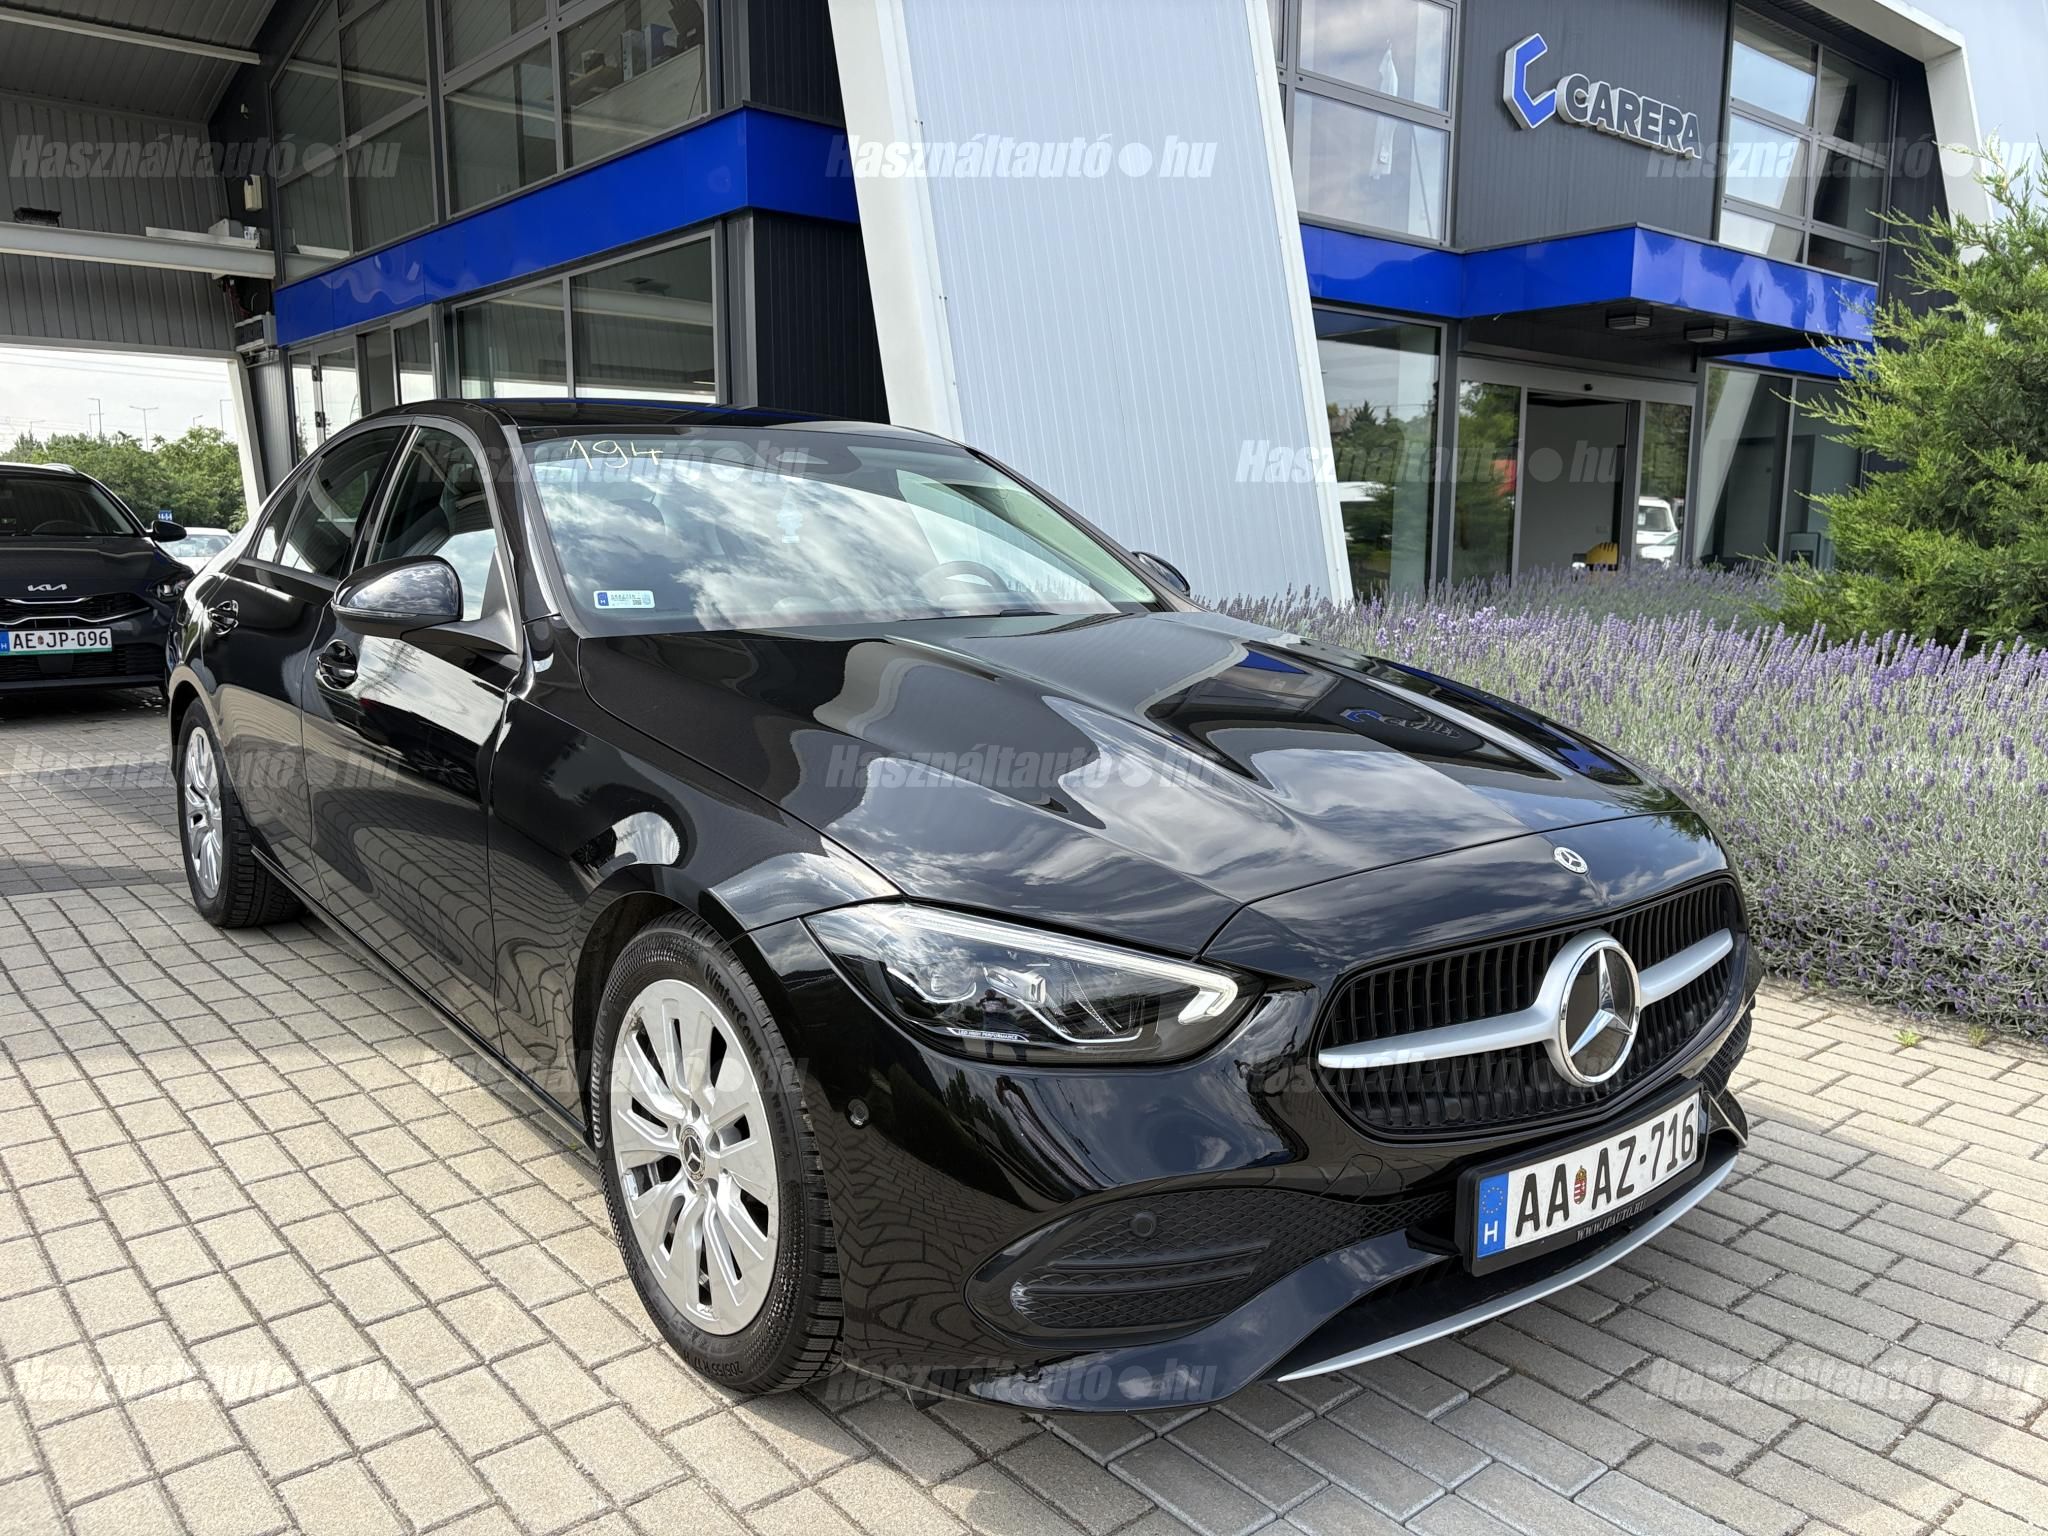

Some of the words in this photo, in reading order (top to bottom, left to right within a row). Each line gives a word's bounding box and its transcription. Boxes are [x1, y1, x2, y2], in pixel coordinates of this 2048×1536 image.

[1557, 73, 1701, 159] CARERA
[566, 440, 664, 469] 194
[1483, 1220, 1499, 1245] H
[1515, 1163, 1570, 1238] AA
